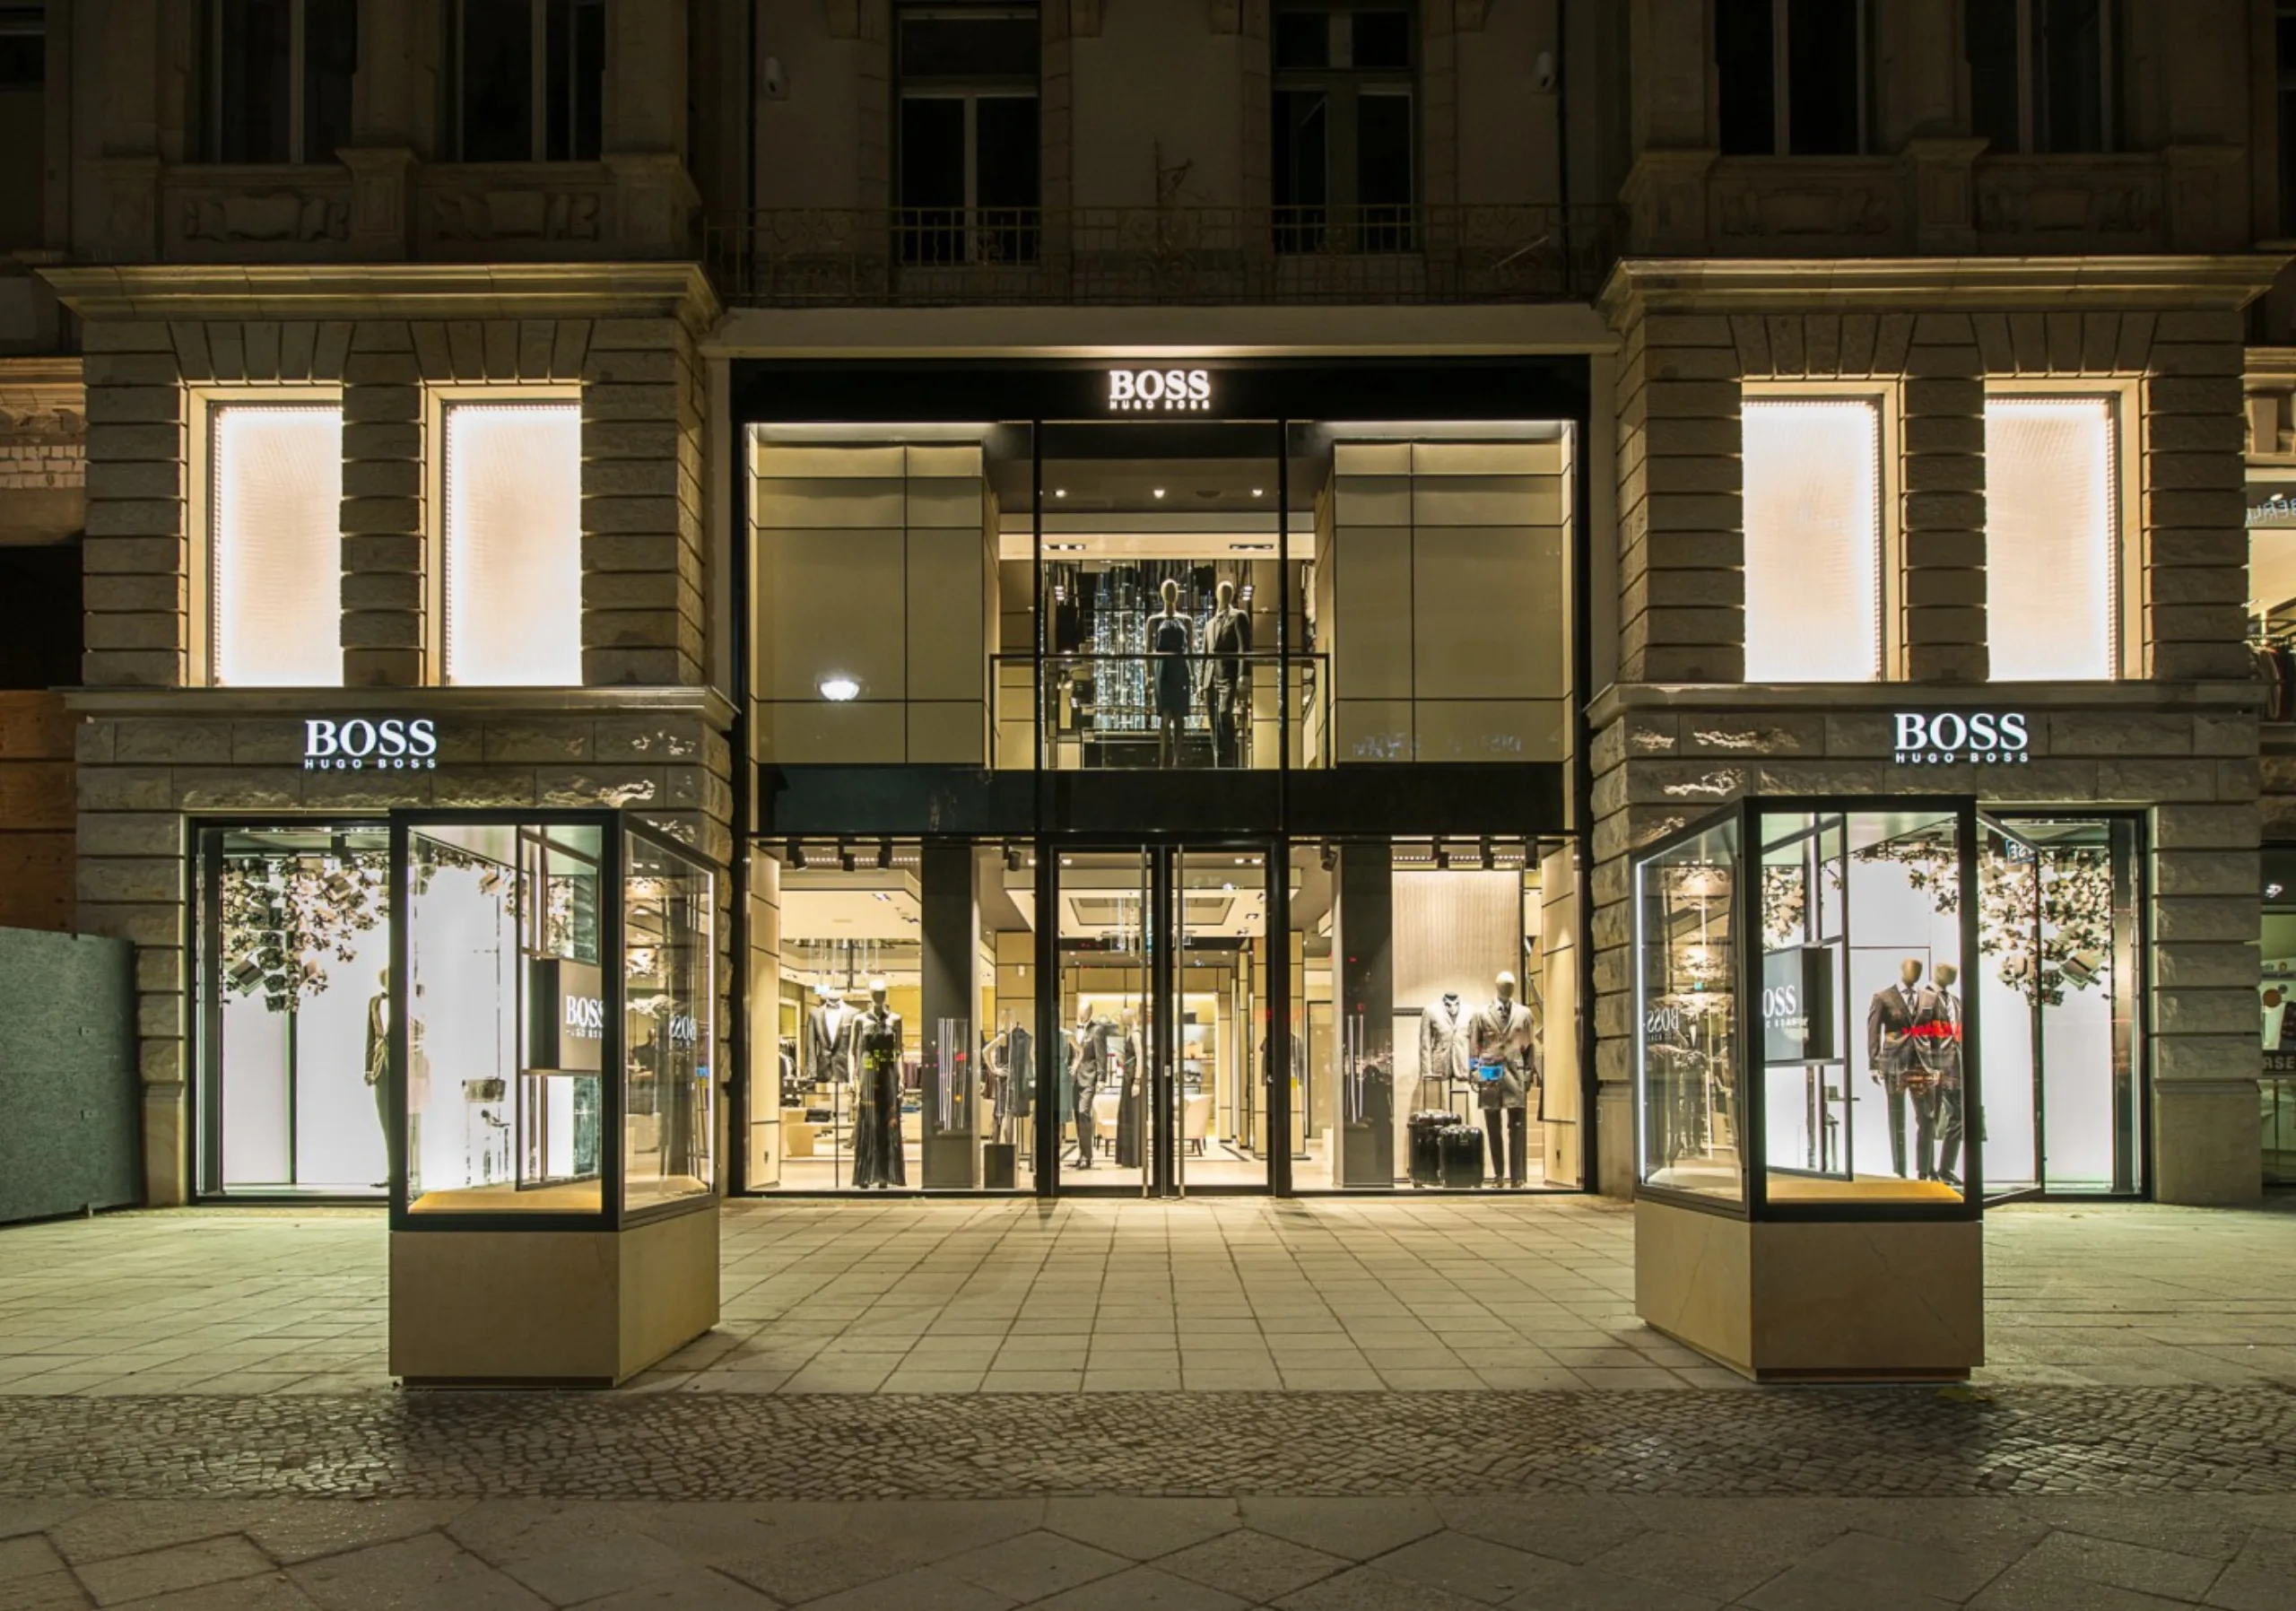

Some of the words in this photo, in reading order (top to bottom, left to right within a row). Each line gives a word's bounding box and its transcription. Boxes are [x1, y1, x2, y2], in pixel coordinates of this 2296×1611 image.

[1109, 370, 1211, 400] BOSS
[1109, 400, 1154, 410] HUGO
[1164, 400, 1210, 410] BOSS
[304, 719, 437, 756] BOSS
[1894, 713, 2029, 750] BOSS
[304, 759, 362, 769] HUGO
[378, 759, 436, 769] BOSS
[1895, 753, 1954, 763] HUGO
[1970, 753, 2029, 763] BOSS
[1762, 985, 1796, 1018] OSS
